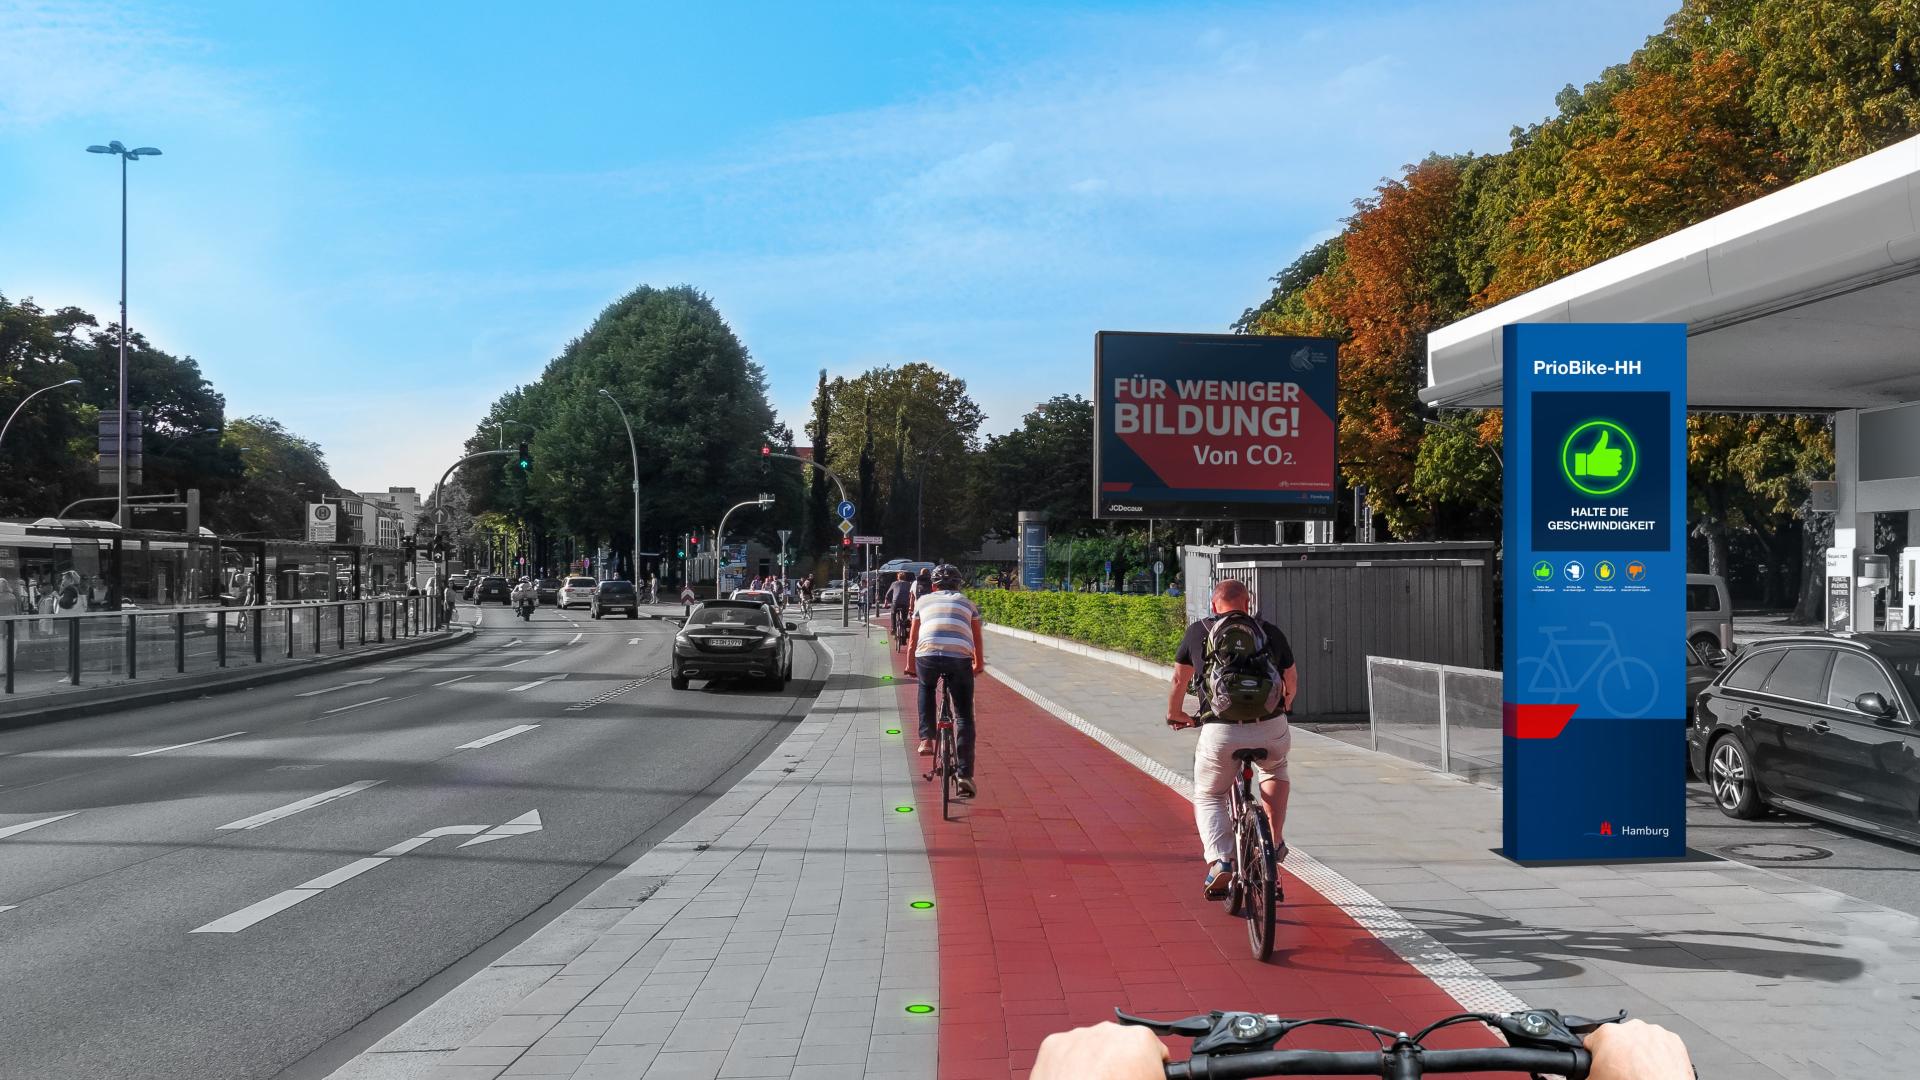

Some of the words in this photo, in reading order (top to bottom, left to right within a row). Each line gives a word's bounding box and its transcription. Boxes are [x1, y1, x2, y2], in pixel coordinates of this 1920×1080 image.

[1533, 360, 1642, 375] PrioBike-HH
[1114, 374, 1167, 399] FÜR
[1176, 380, 1300, 402] WENIGER
[1114, 403, 1300, 437] BILDUNG!
[1193, 446, 1238, 465] Von
[1109, 504, 1143, 512] JCDecaux
[1571, 507, 1607, 517] HALTE
[1609, 507, 1629, 517] DIE
[1547, 521, 1656, 531] GESCHWINDIGKEIT
[1622, 826, 1669, 838] Hamburg
